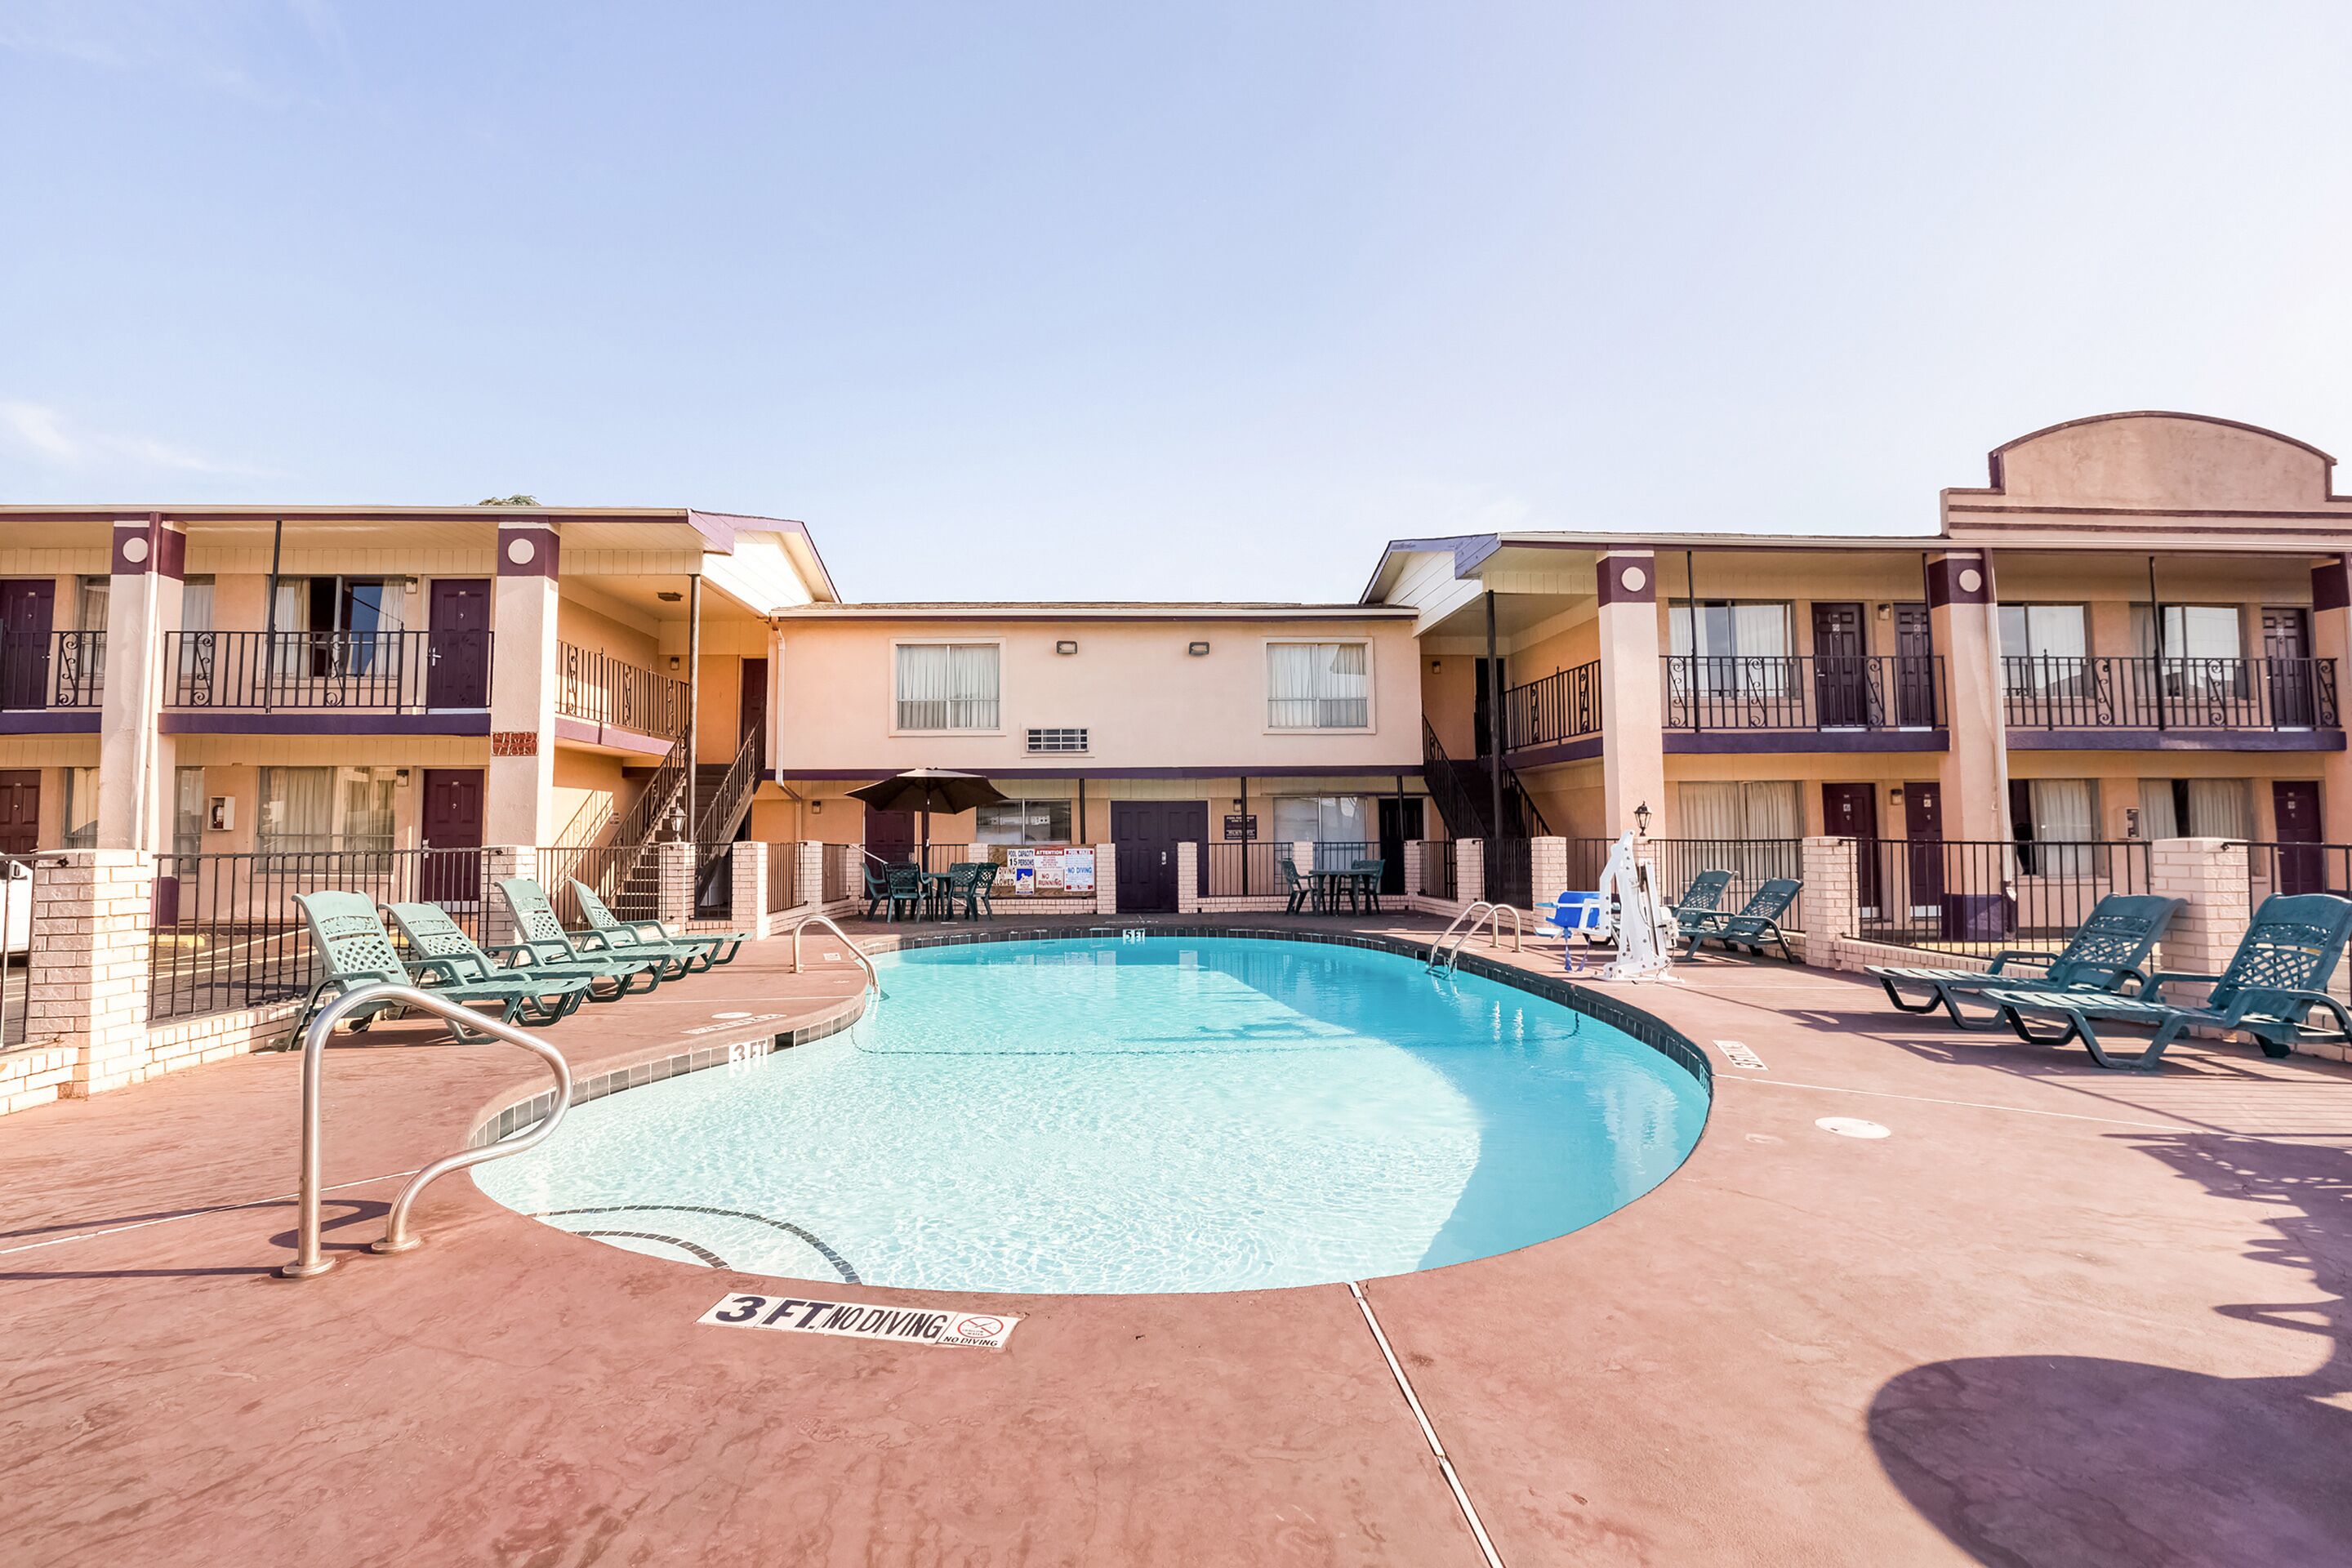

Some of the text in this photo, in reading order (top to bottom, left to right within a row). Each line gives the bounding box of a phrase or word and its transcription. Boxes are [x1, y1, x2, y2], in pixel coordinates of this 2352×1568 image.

[733, 1040, 766, 1062] 3 FT
[715, 1296, 767, 1323] 3
[823, 1306, 864, 1332] NO
[862, 1311, 948, 1339] DIVING
[960, 1338, 998, 1346] DIVING
